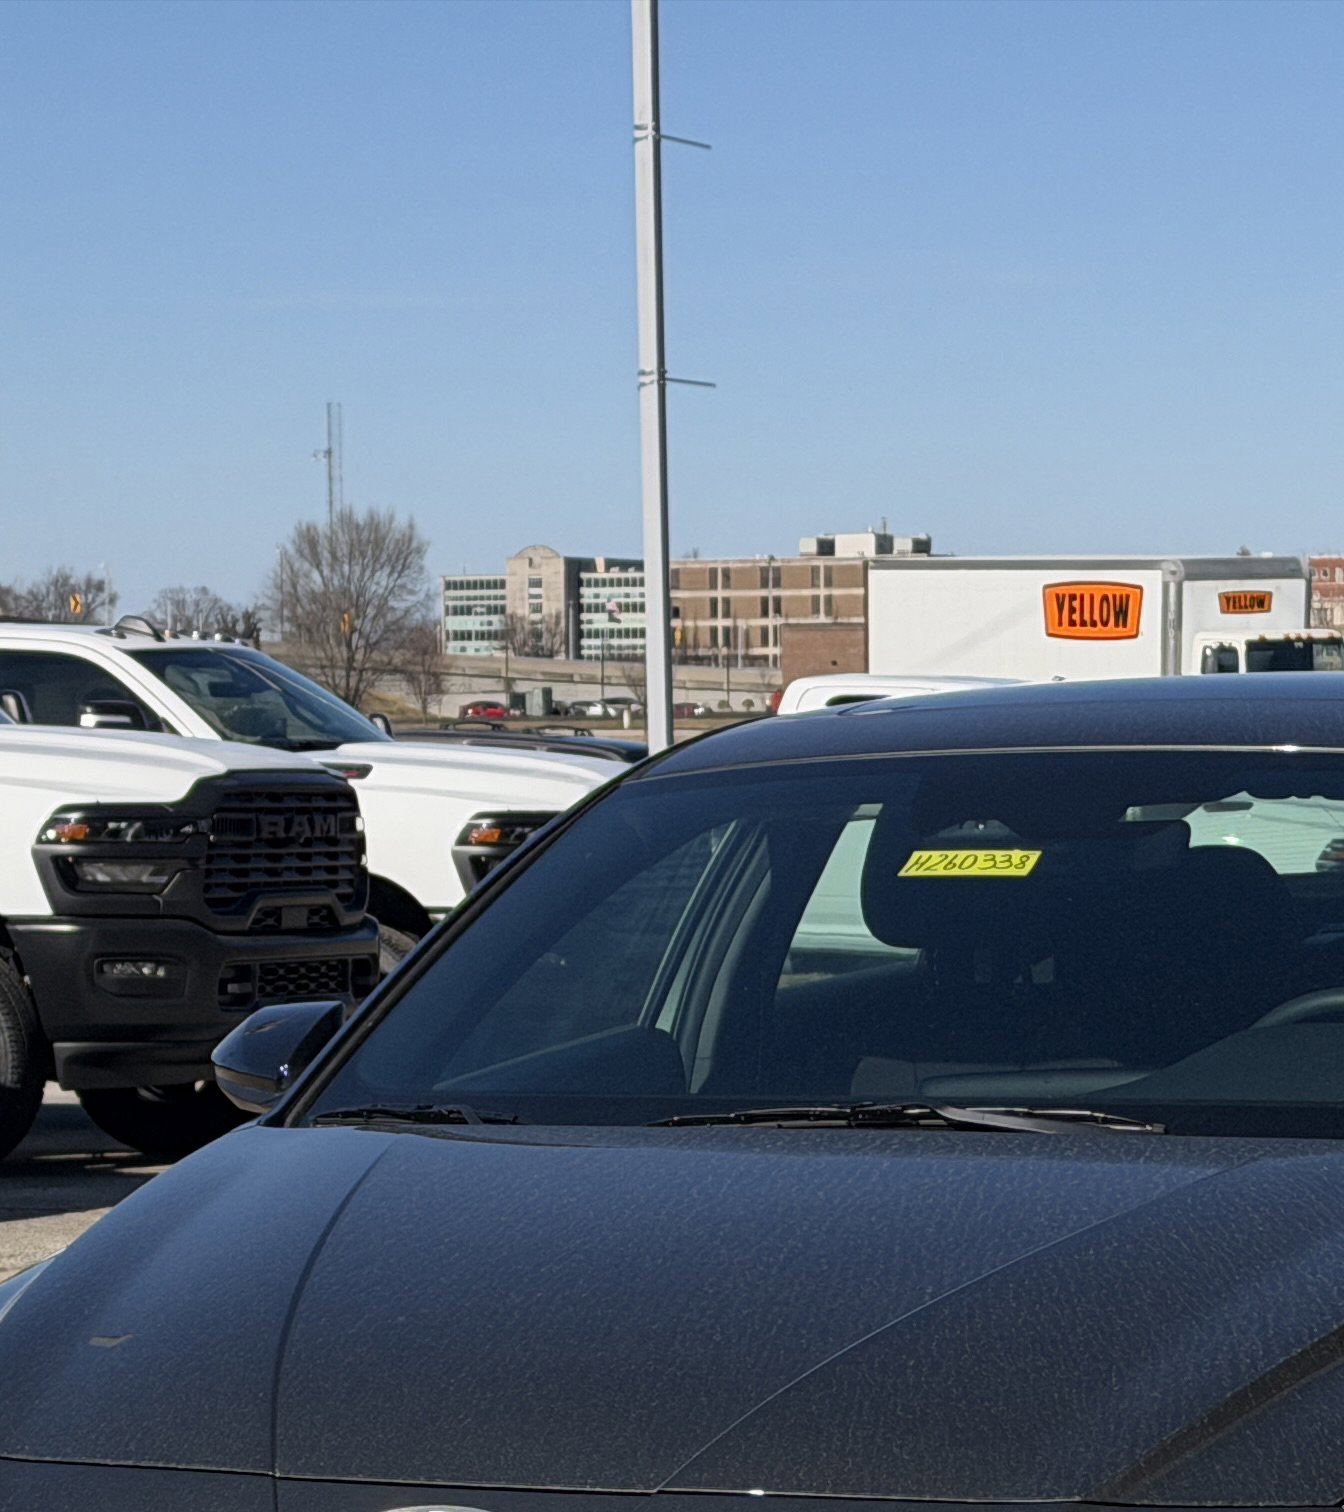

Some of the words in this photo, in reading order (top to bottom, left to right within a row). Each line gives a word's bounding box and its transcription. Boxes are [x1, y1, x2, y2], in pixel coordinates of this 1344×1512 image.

[1055, 592, 1131, 629] YELLOW
[1223, 594, 1266, 610] YELLOW
[259, 814, 335, 839] RAM
[905, 853, 1031, 873] H260338
